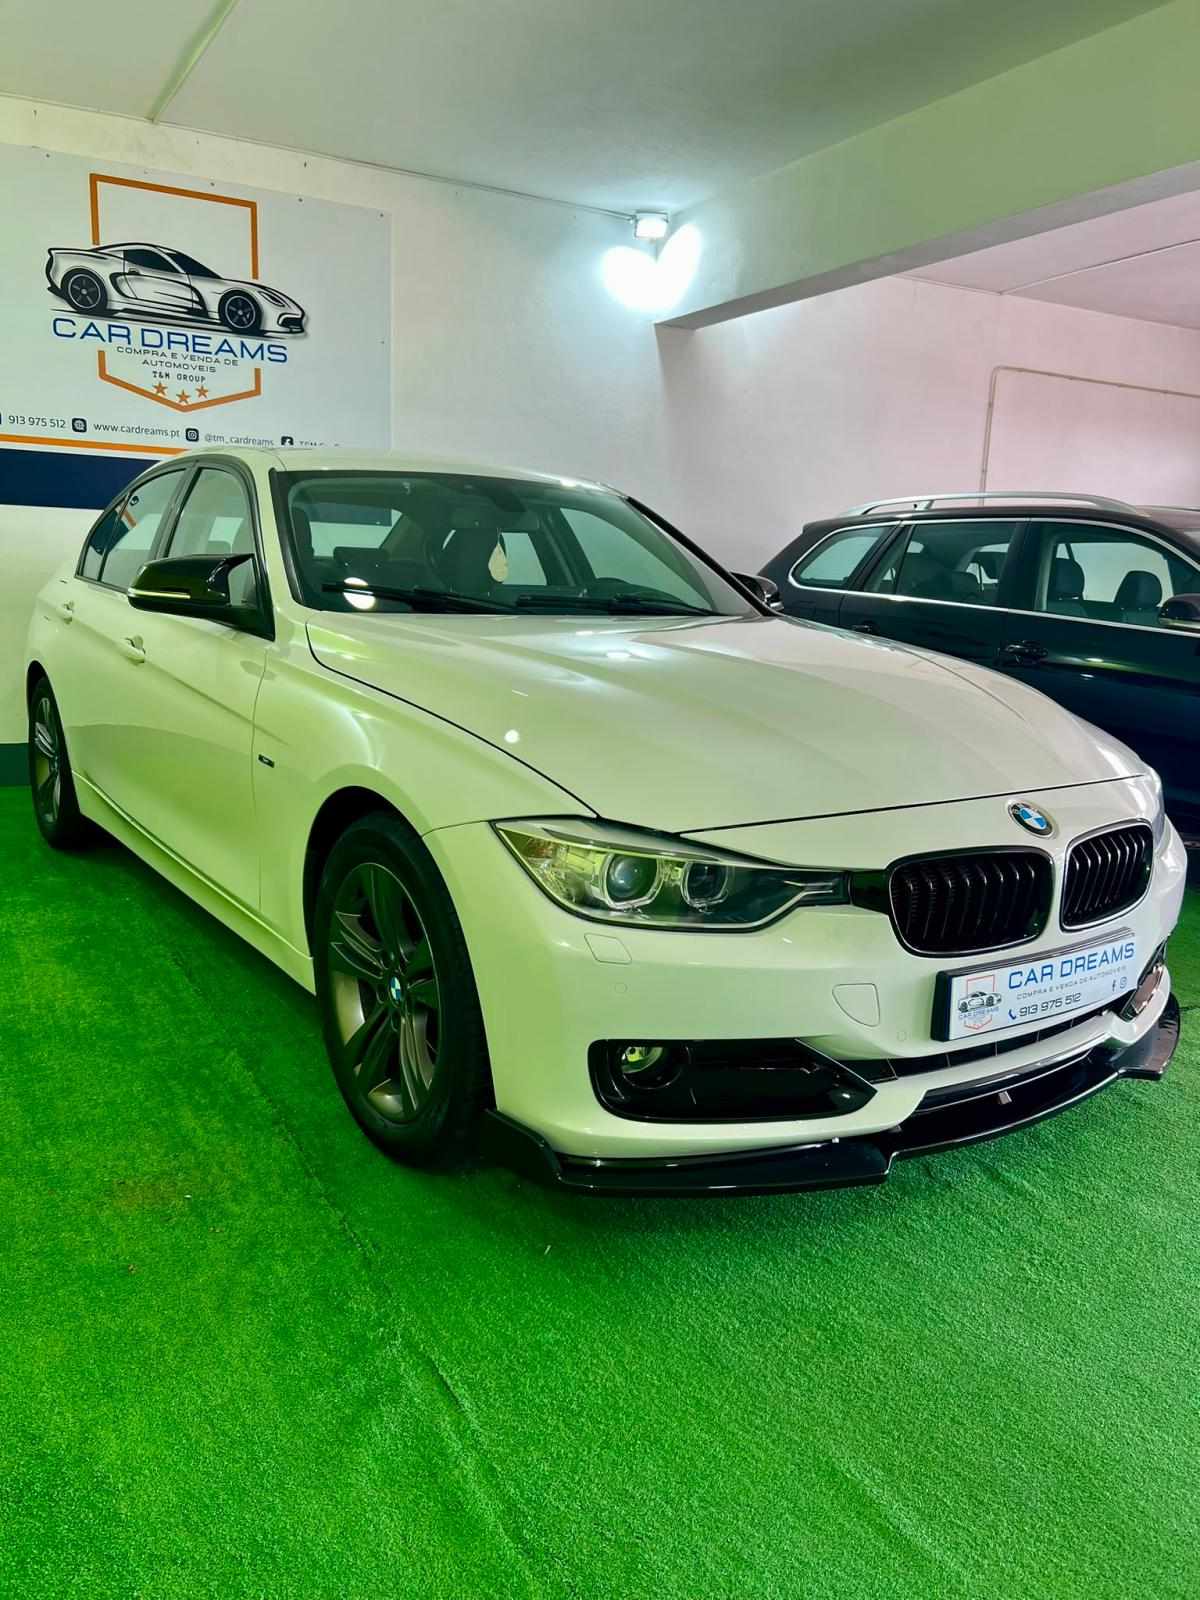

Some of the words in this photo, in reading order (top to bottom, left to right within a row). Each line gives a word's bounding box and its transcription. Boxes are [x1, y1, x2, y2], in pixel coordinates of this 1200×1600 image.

[52, 318, 131, 346] CAR
[142, 329, 288, 363] DREAMS
[117, 346, 167, 358] COMPRA
[181, 354, 220, 364] VENDA
[152, 371, 170, 379] T&M
[177, 373, 206, 383] GROUP
[8, 415, 26, 425] 913
[28, 416, 47, 427] 975
[50, 418, 66, 428] 512
[93, 422, 180, 438] www.cardreams.pt
[1008, 963, 1054, 990] CAR
[1060, 942, 1135, 978] DREAMS
[1019, 1003, 1038, 1017] 913
[1041, 998, 1063, 1012] 975
[1065, 992, 1081, 1005] 512
